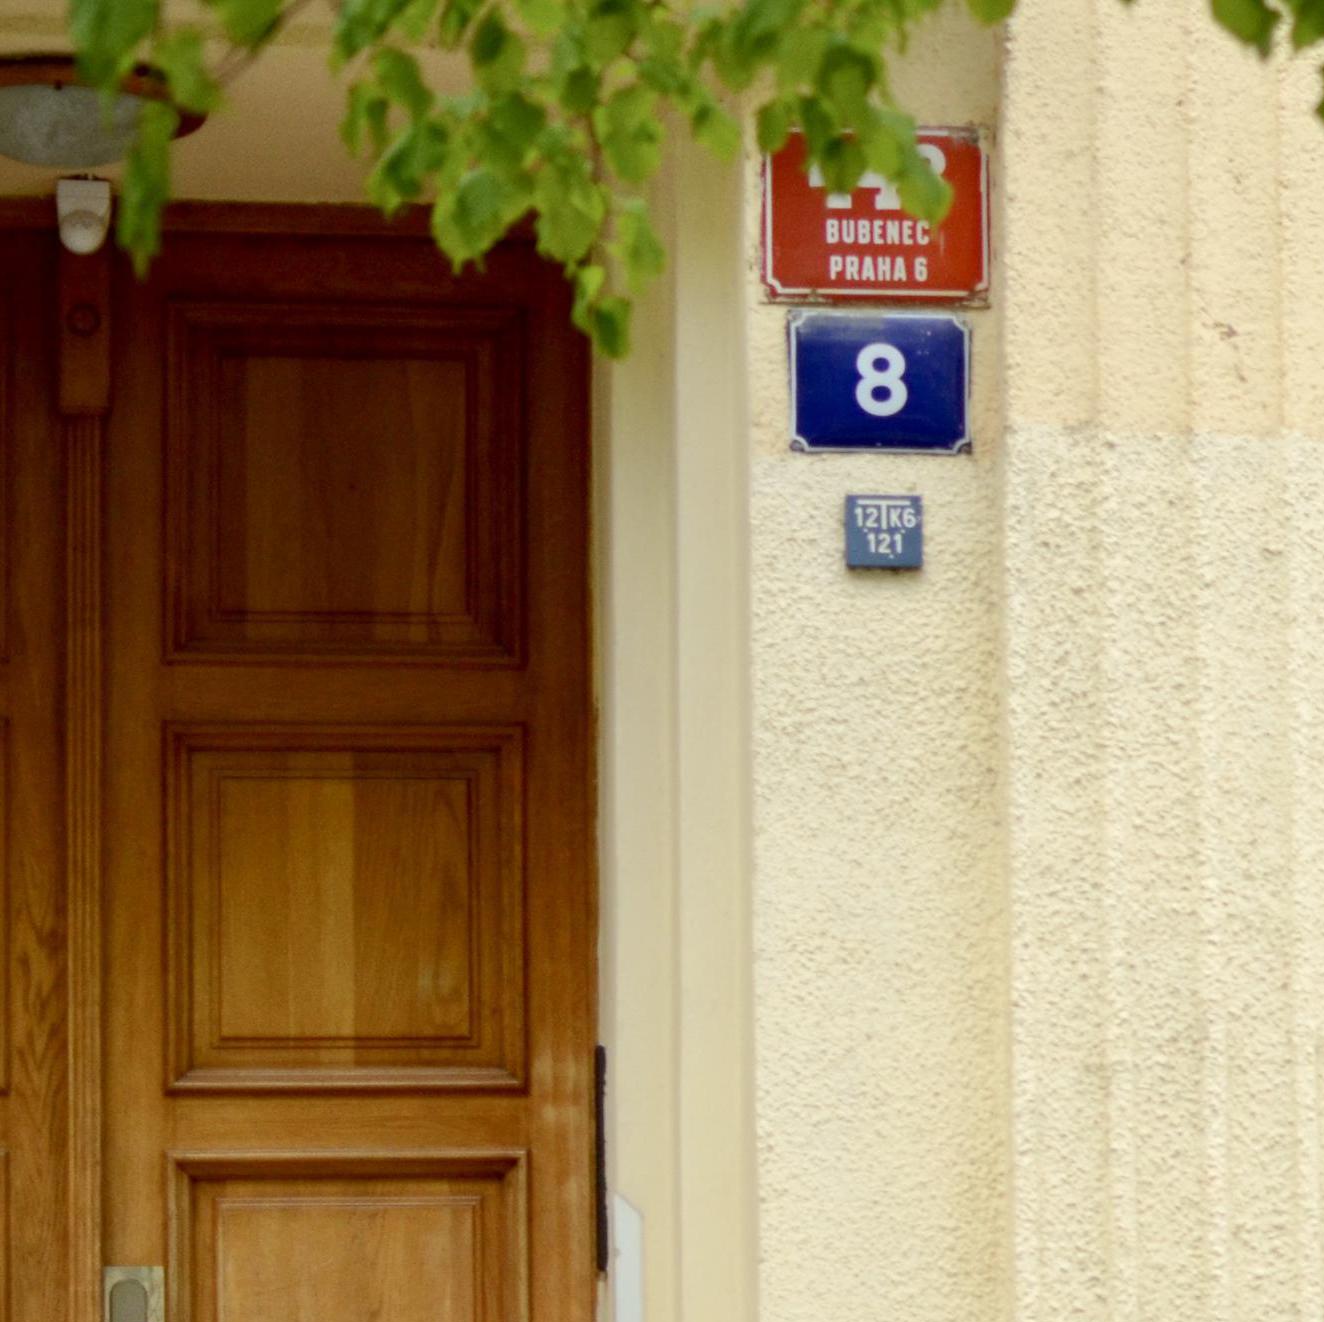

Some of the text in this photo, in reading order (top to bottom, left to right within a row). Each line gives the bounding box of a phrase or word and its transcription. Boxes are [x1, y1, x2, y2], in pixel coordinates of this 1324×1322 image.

[830, 255, 928, 282] PRAHA 6
[855, 342, 908, 417] 8
[867, 533, 903, 555] 121
